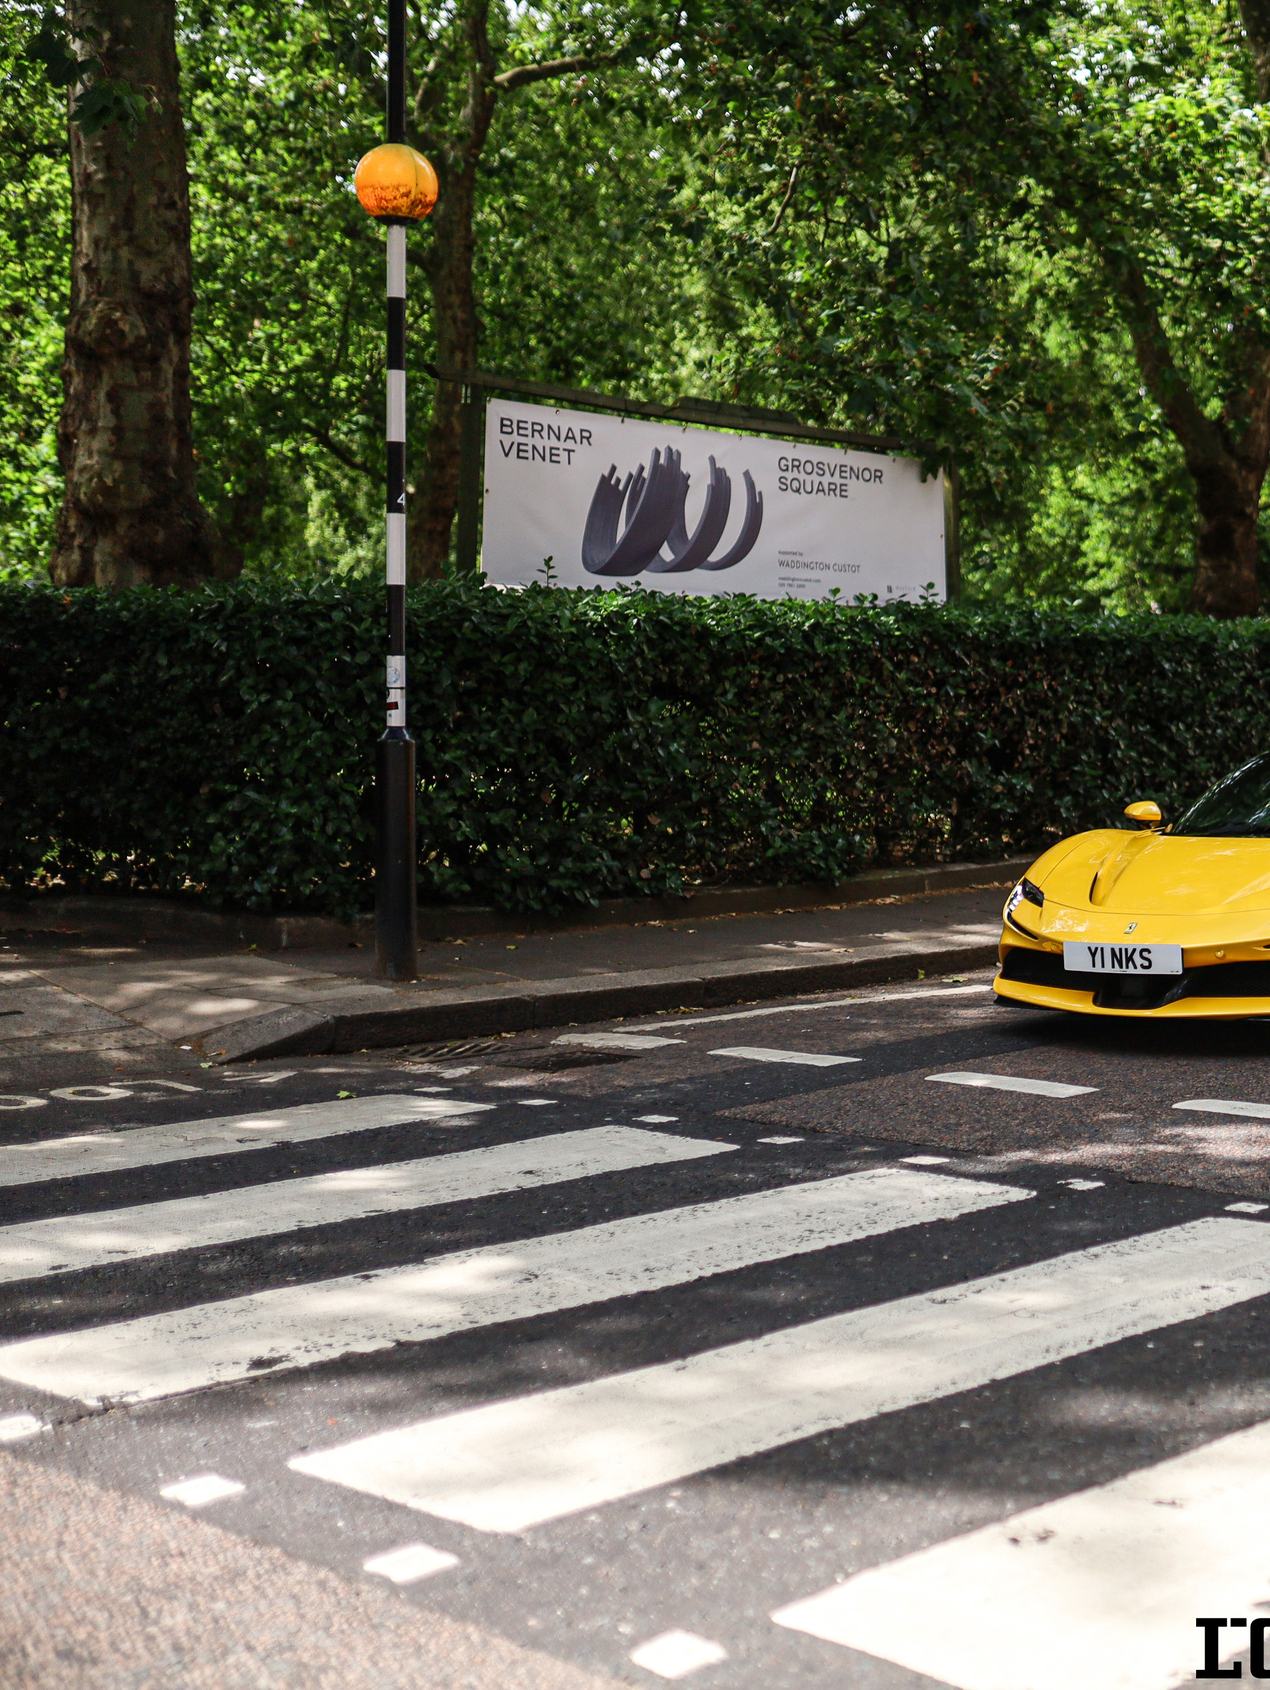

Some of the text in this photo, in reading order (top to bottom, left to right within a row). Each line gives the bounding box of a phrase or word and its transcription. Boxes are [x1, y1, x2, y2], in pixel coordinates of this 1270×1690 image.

[500, 417, 593, 446] BERNAR
[499, 439, 576, 465] VENET
[778, 456, 884, 484] GROSVENOR
[778, 476, 848, 498] SQUARE
[778, 559, 860, 574] WADDINGTON CUSTOT
